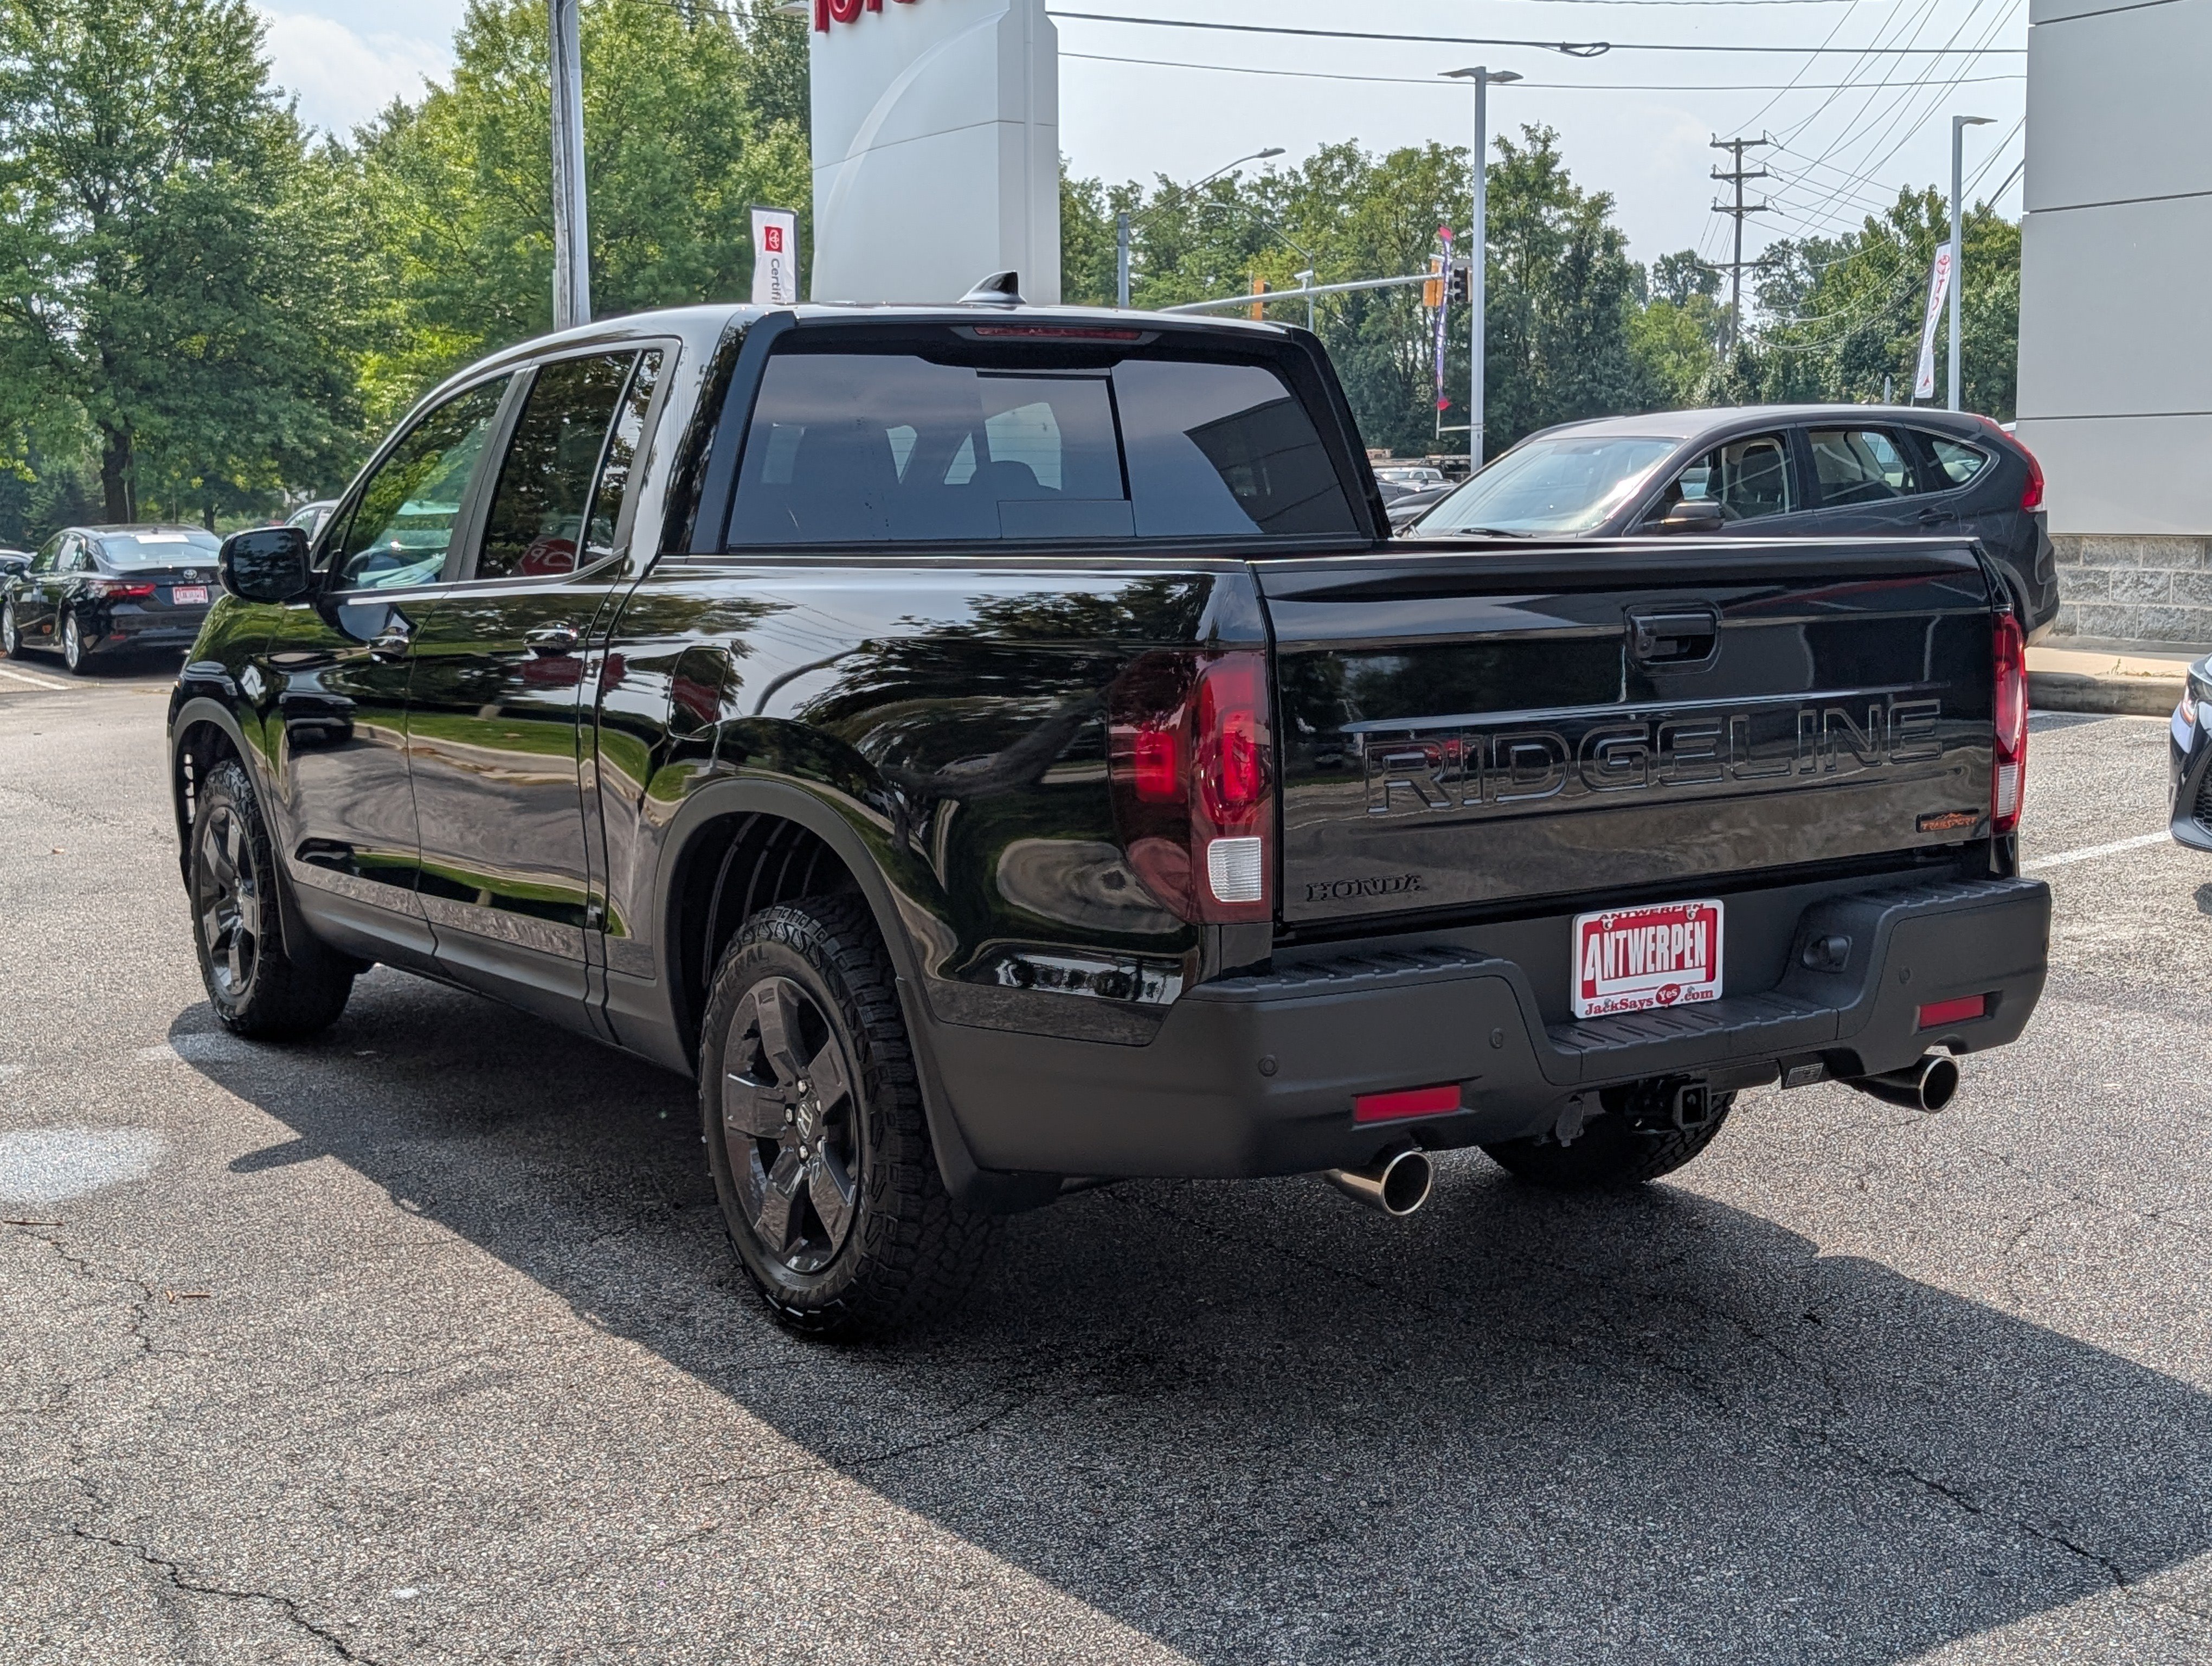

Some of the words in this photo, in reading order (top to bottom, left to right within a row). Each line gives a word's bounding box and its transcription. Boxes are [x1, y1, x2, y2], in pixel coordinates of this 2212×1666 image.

[1364, 699, 1943, 814] RIDGELINE
[1922, 817, 1977, 831] TRAILSPORT
[1306, 873, 1428, 902] HONDA
[1599, 903, 1704, 920] ANTWERPEN
[1583, 920, 1706, 996] ANTWERPEN
